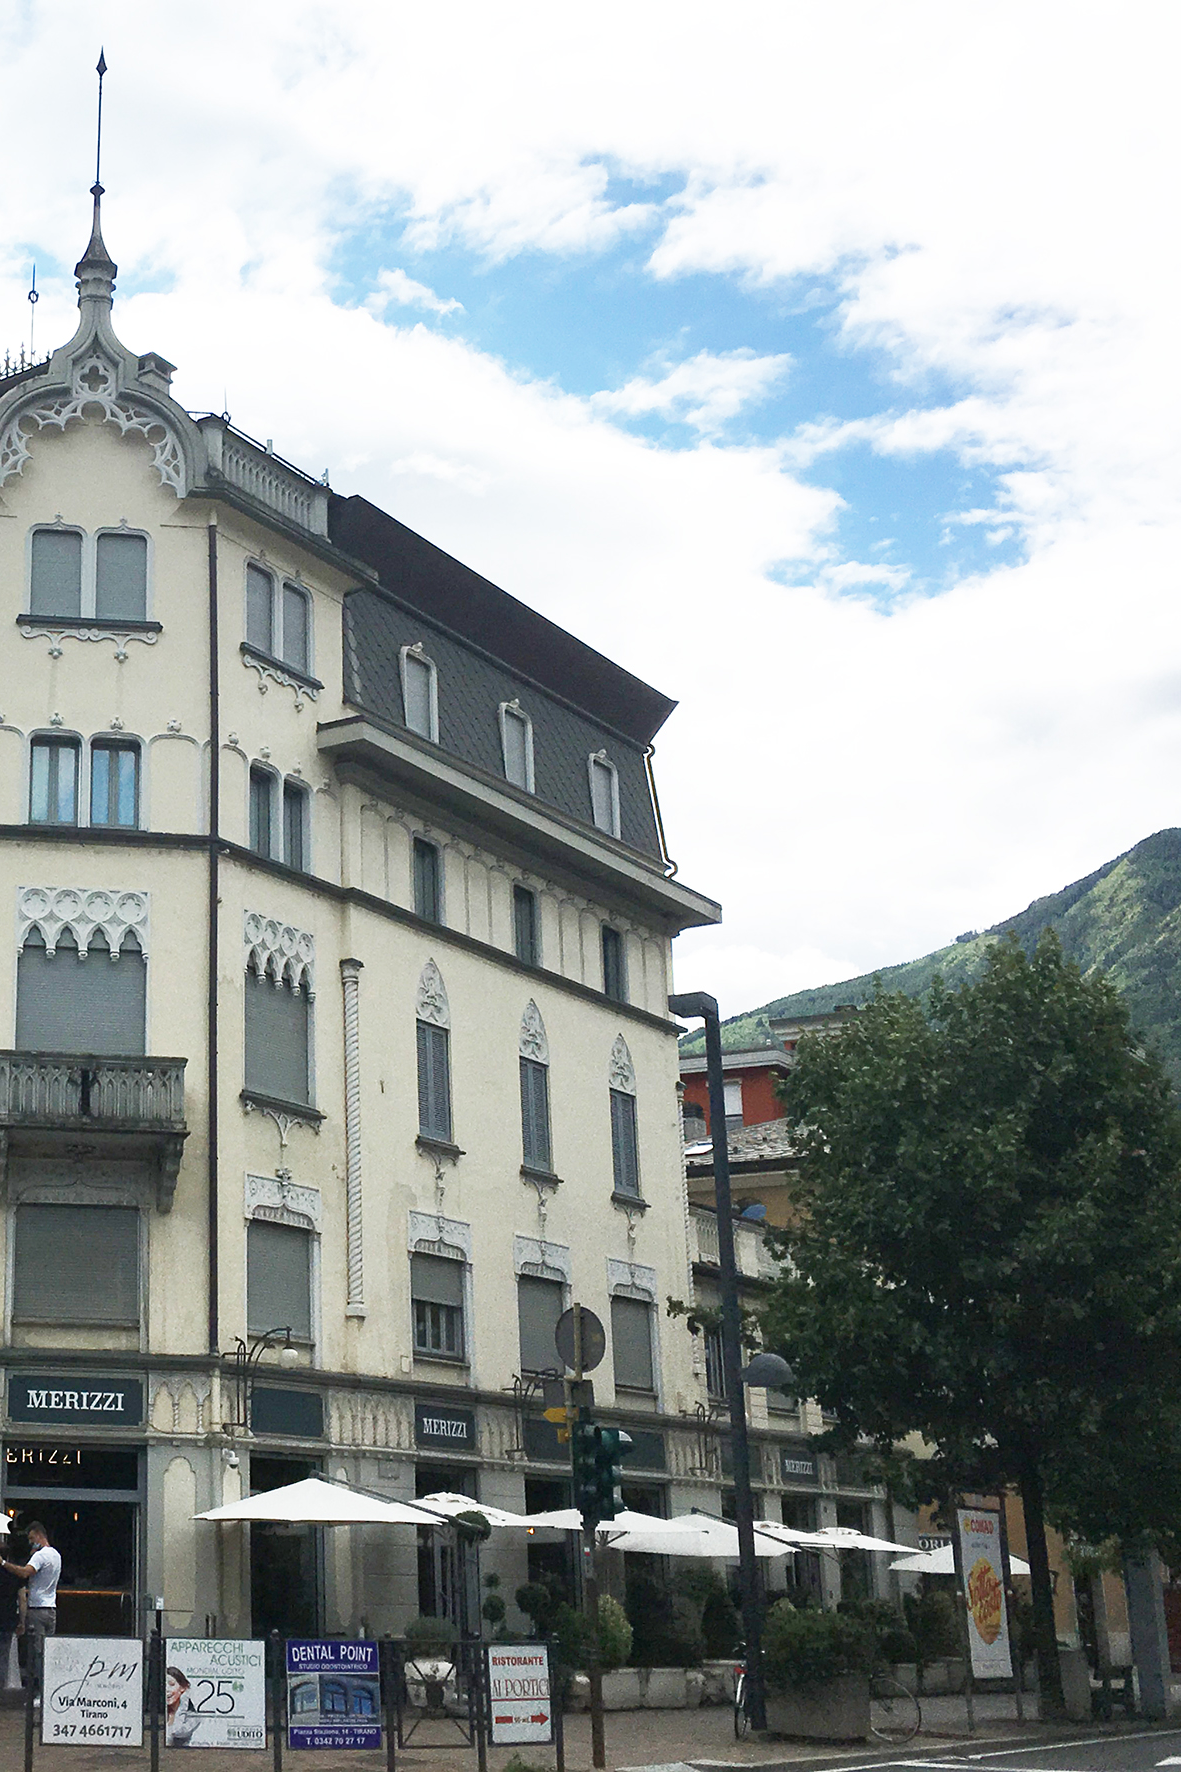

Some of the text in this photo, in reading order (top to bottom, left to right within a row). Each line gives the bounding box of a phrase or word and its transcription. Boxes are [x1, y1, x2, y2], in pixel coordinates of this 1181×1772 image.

[27, 1390, 124, 1411] MERIZZI
[423, 1417, 467, 1438] MERIZZI
[171, 1641, 244, 1654] APPARECCHI
[292, 1645, 373, 1662] DENTAL POINT
[210, 1654, 261, 1667] ACUSTICI
[492, 1656, 544, 1666] RISTORANTE
[505, 1678, 550, 1697] PORTICI
[58, 1696, 75, 1707] Via
[197, 1680, 235, 1714] 25
[81, 1709, 108, 1719] Tirano
[53, 1724, 132, 1738] 347 4661717
[314, 1737, 333, 1745] 0342
[334, 1737, 344, 1745] 70
[345, 1737, 354, 1745] 27
[357, 1737, 365, 1745] 17
